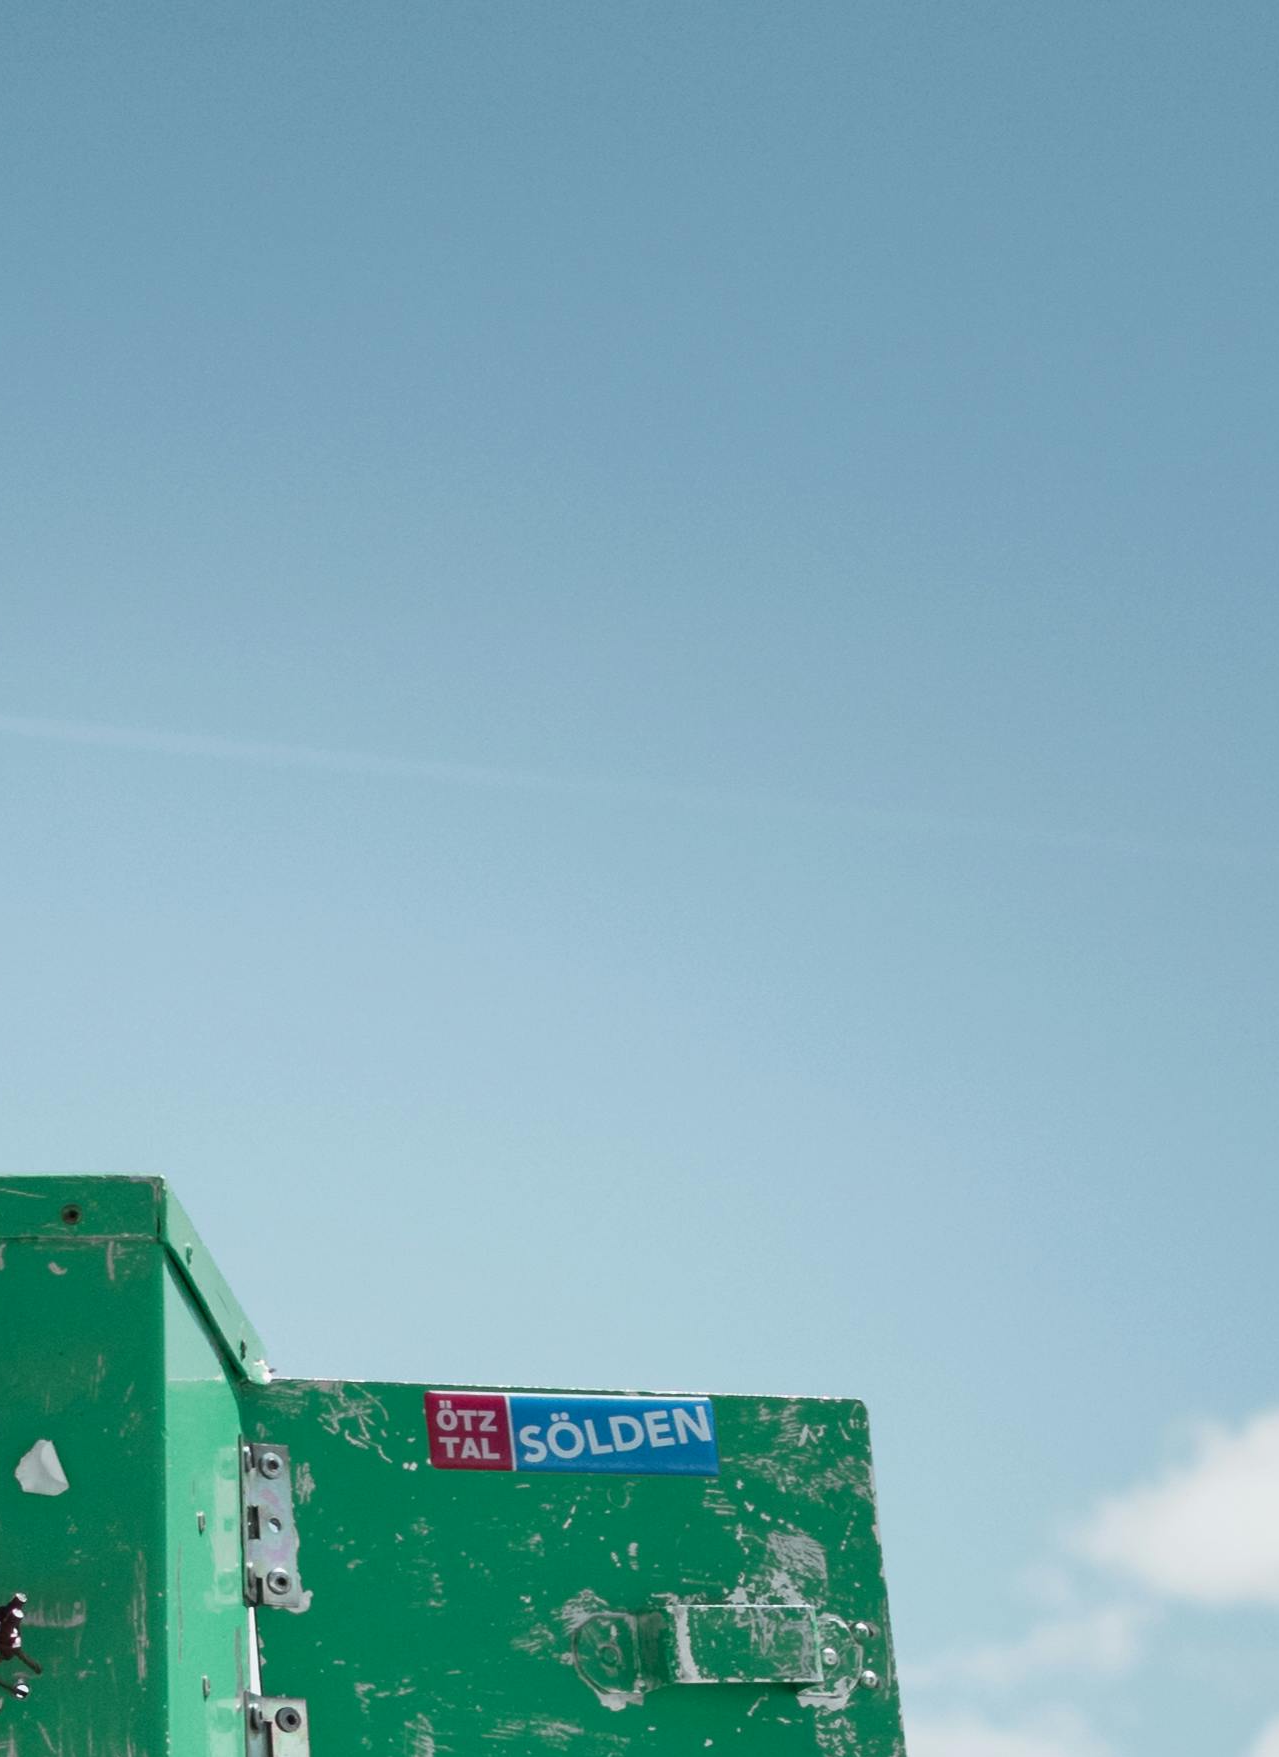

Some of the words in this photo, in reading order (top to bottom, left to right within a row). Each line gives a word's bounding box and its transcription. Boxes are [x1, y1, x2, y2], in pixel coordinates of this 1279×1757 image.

[436, 1400, 498, 1432] ÖTZ
[438, 1436, 500, 1460] TAL
[518, 1405, 713, 1463] SÖLDEN
